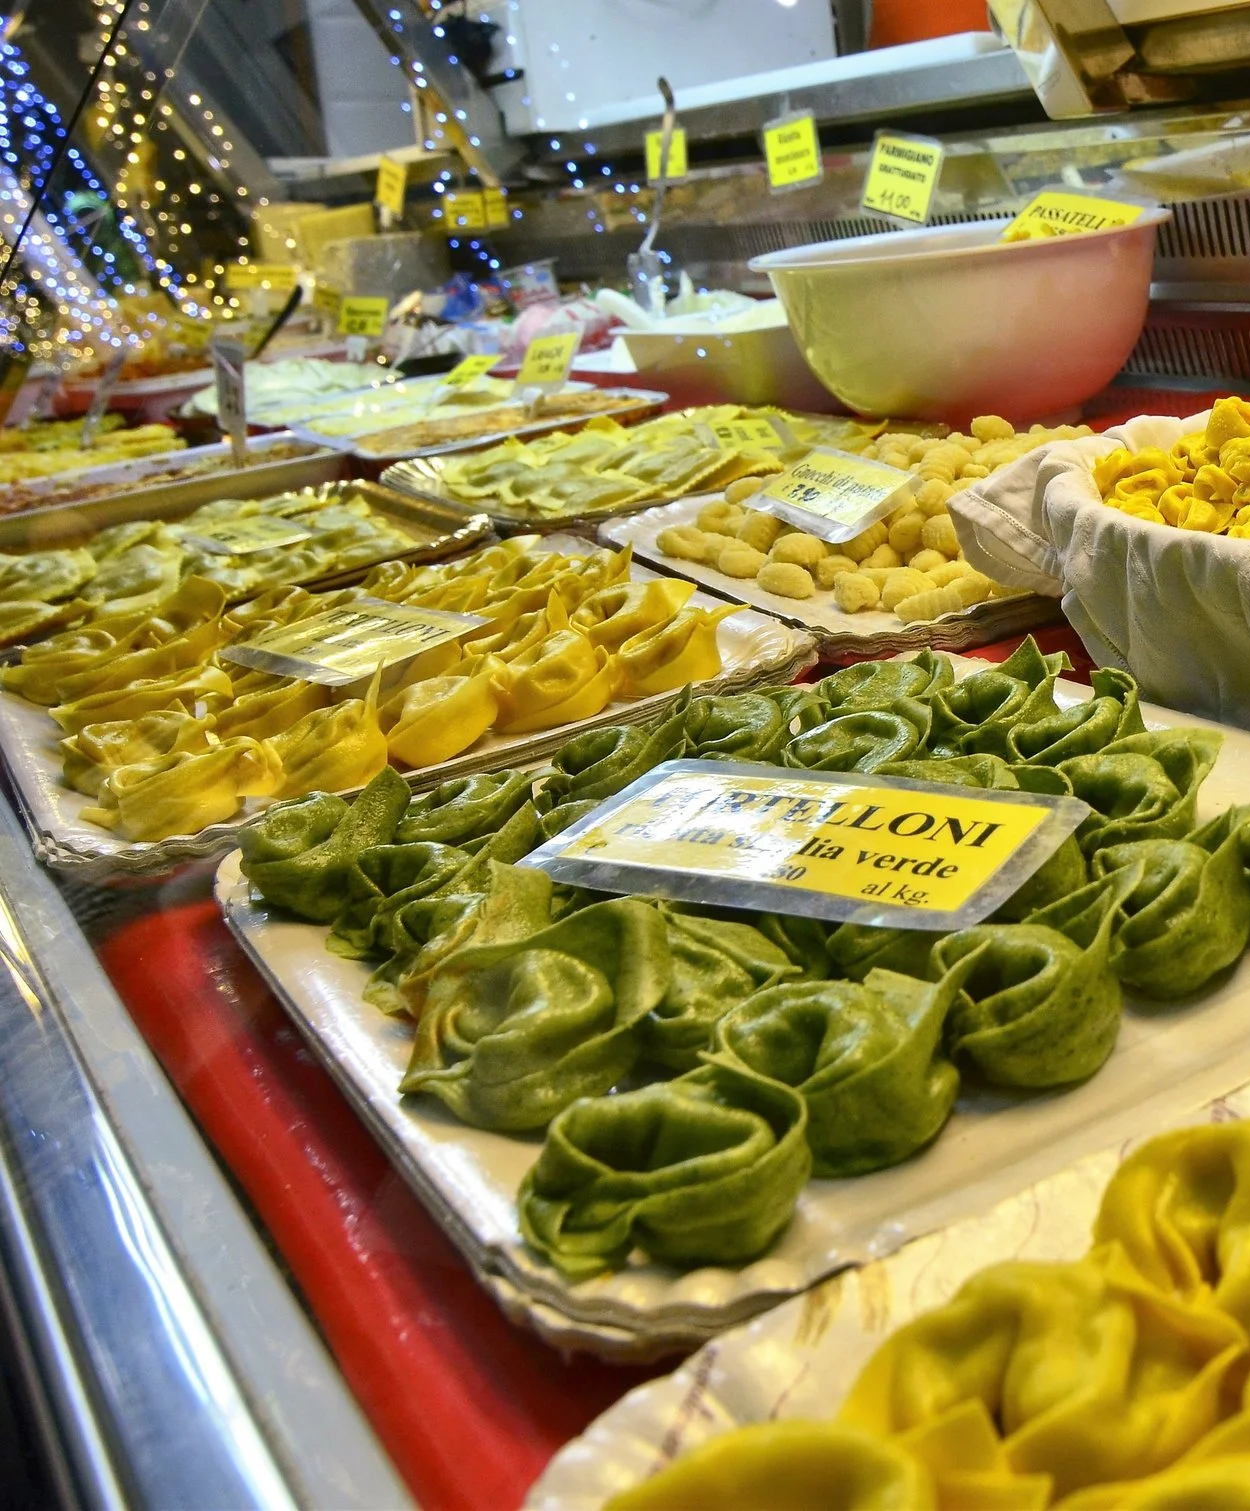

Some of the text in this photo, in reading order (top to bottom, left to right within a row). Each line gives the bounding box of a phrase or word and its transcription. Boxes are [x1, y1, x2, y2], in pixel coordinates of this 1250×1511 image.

[1027, 205, 1113, 230] PASSATELL
[856, 849, 959, 880] verde
[861, 881, 892, 896] al
[892, 884, 930, 906] kg.
